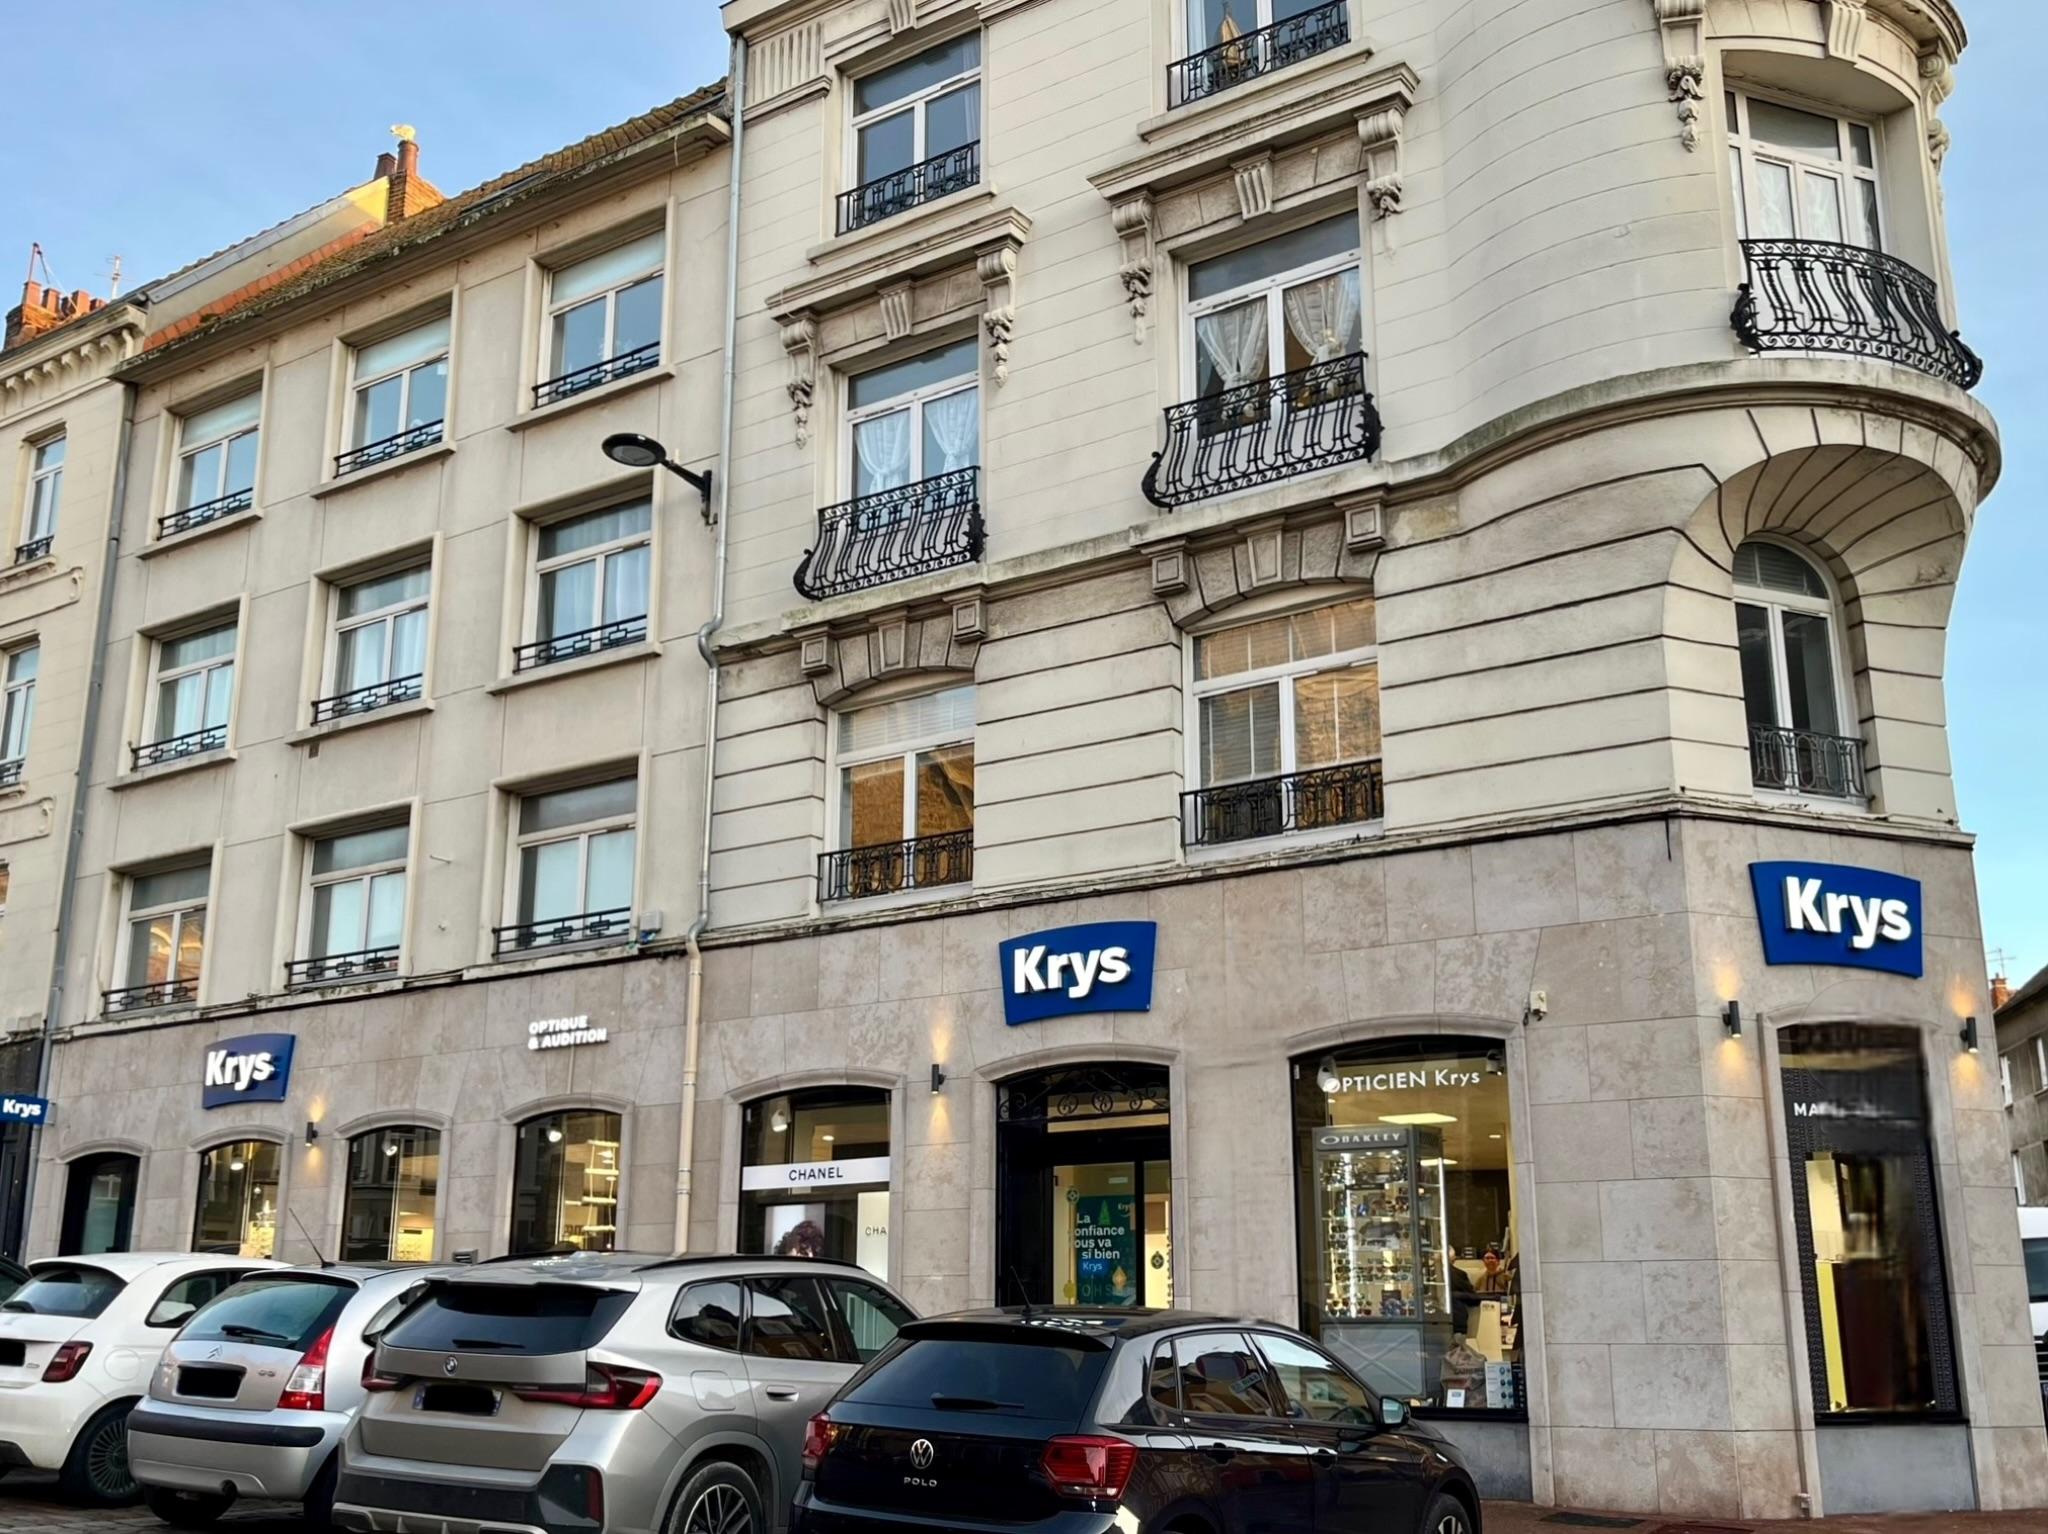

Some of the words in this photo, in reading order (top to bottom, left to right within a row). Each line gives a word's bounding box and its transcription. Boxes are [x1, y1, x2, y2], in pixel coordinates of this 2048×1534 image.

[1784, 876, 1912, 949] Krys
[1014, 945, 1131, 999] Krys
[528, 1015, 588, 1035] OPTIQUE
[541, 1027, 607, 1048] AUDITION
[205, 1049, 275, 1091] Krys
[1435, 1069, 1481, 1087] Krys
[3, 1098, 42, 1118] Krys
[788, 1166, 844, 1181] CHANEL
[1076, 1212, 1091, 1224] La
[864, 1225, 888, 1236] CHA
[1074, 1225, 1126, 1236] onfiance
[1074, 1238, 1095, 1248] ous
[1097, 1238, 1112, 1248] va
[1081, 1249, 1092, 1259] si
[1094, 1248, 1121, 1260] bien
[1082, 1261, 1103, 1272] Krys
[903, 1476, 938, 1487] POLO
